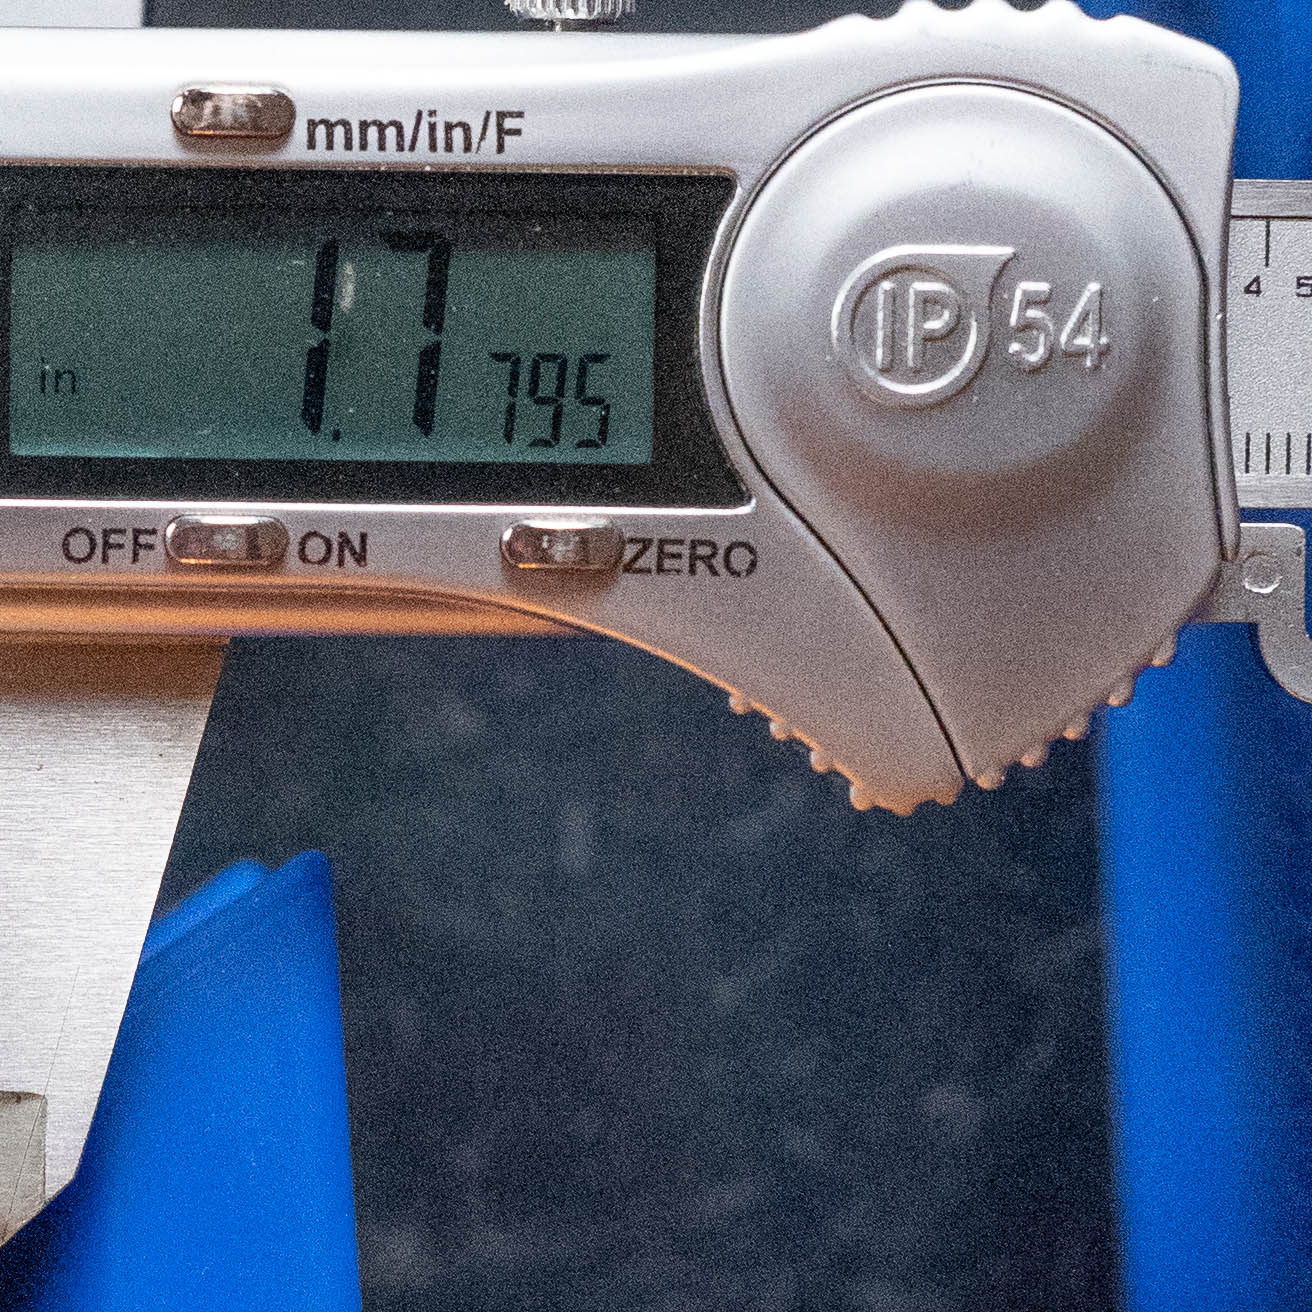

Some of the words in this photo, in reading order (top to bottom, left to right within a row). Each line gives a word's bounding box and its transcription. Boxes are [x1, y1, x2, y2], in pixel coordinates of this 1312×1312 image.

[305, 109, 527, 155] mm/in/F
[1243, 274, 1263, 297] 4
[1295, 275, 1312, 298] 5
[874, 280, 962, 370] IP
[1007, 280, 1108, 371] 54
[38, 355, 80, 397] in
[59, 525, 160, 567] OFF
[295, 528, 371, 570] ON
[620, 534, 761, 580] ZERO
